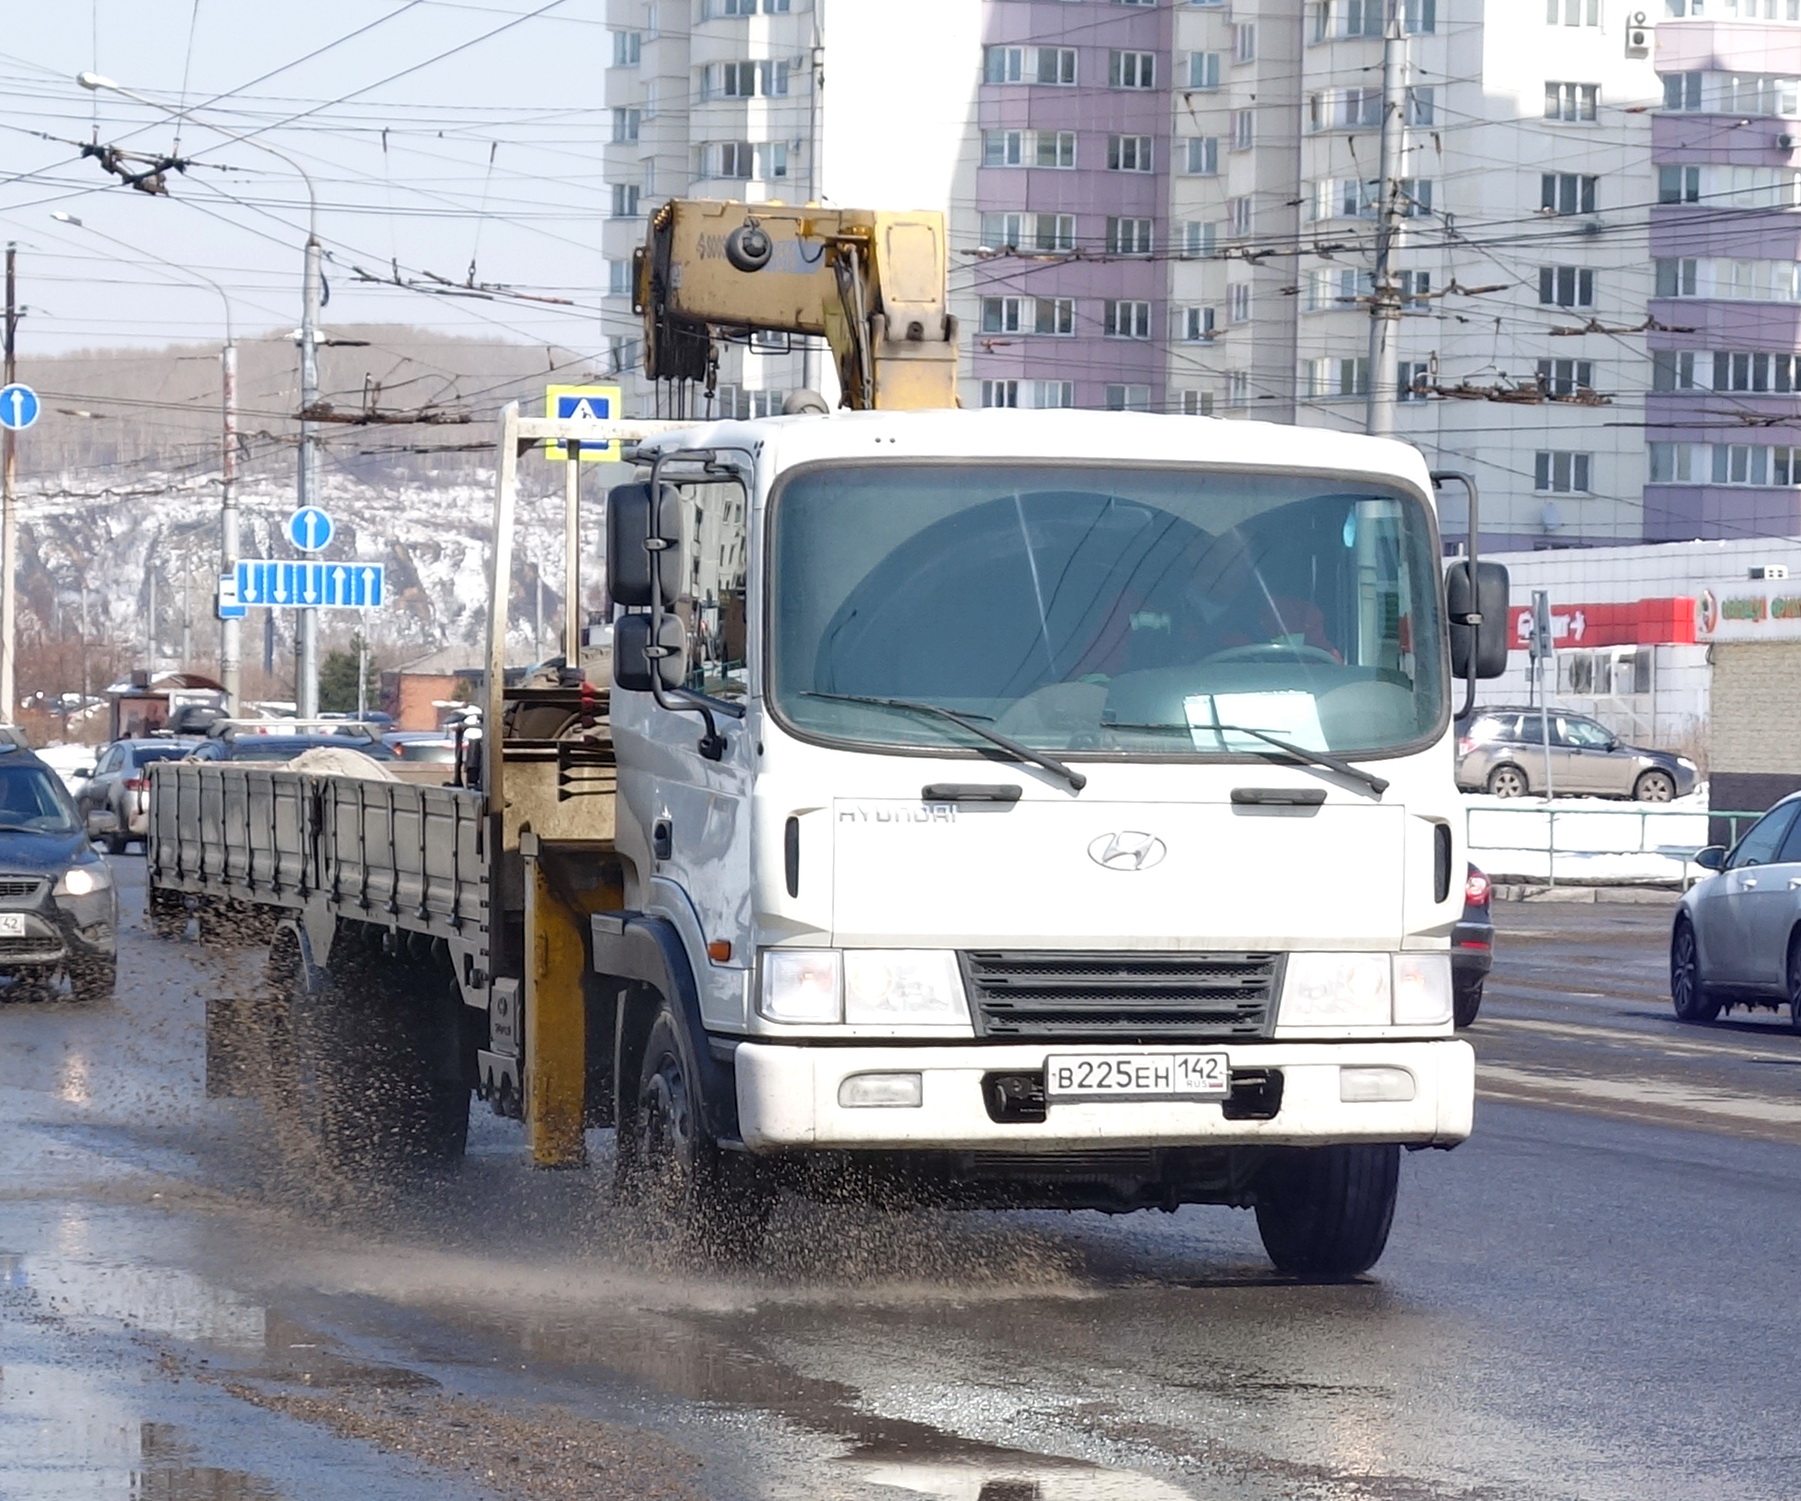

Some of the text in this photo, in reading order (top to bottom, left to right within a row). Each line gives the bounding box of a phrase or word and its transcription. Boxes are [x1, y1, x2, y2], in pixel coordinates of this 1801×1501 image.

[1057, 1058, 1218, 1089] В225ЕН 142
[1186, 1080, 1208, 1088] RUS
